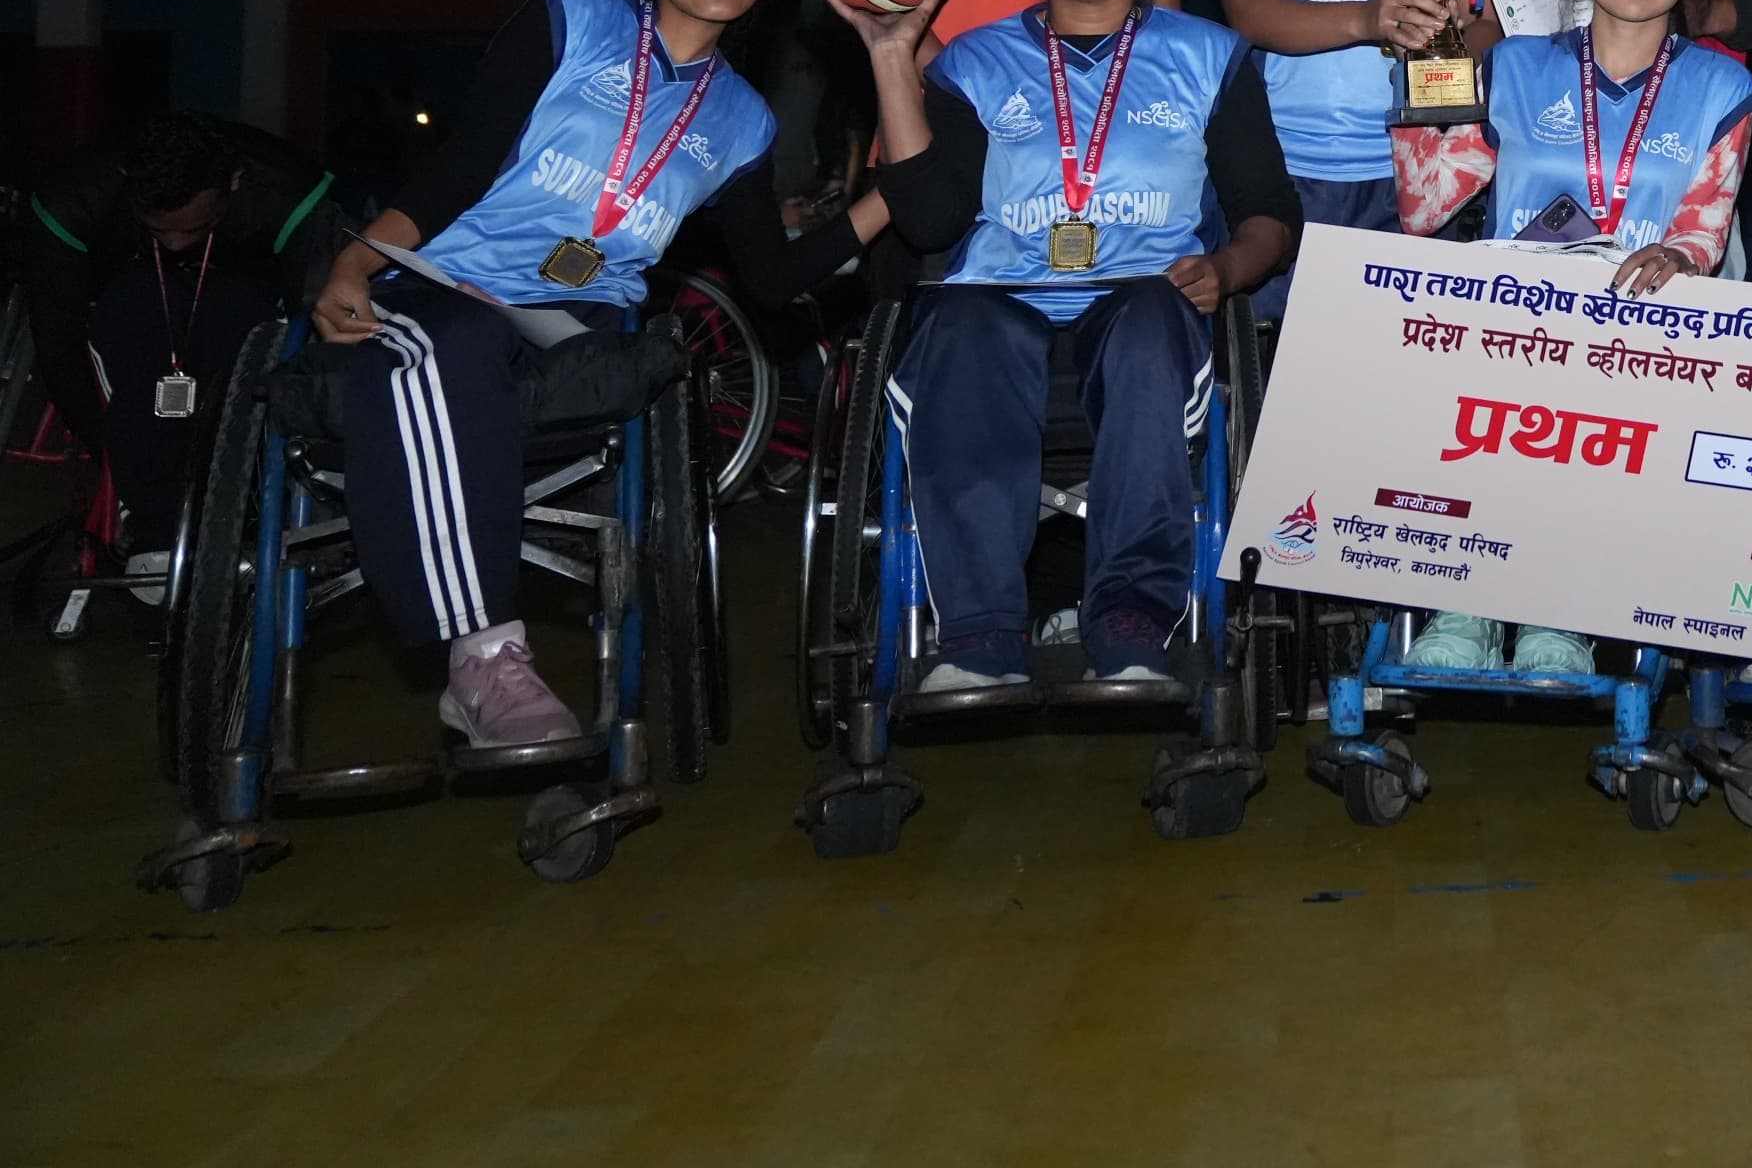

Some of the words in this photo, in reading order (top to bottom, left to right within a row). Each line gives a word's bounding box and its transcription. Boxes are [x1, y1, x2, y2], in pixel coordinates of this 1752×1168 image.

[1425, 72, 1453, 84] प्रथम
[678, 134, 718, 170] SCIS
[1364, 264, 1422, 302] पारा
[1426, 273, 1487, 301] तथा
[1490, 275, 1578, 316] विशेष
[1582, 288, 1709, 339] खेलकुद
[1402, 313, 1469, 352] प्रदेश
[1481, 327, 1574, 367] स्तरीय
[1586, 338, 1723, 392] व्हीलचेयर
[1440, 395, 1659, 475] प्रथम
[1392, 494, 1450, 514] आयोजक
[1332, 515, 1388, 542] राष्ट्रिय
[1395, 523, 1452, 553] खेलकुद
[1459, 533, 1512, 561] परिषद
[1632, 607, 1676, 630] नेपाल
[1683, 617, 1747, 640] स्पाइनल
